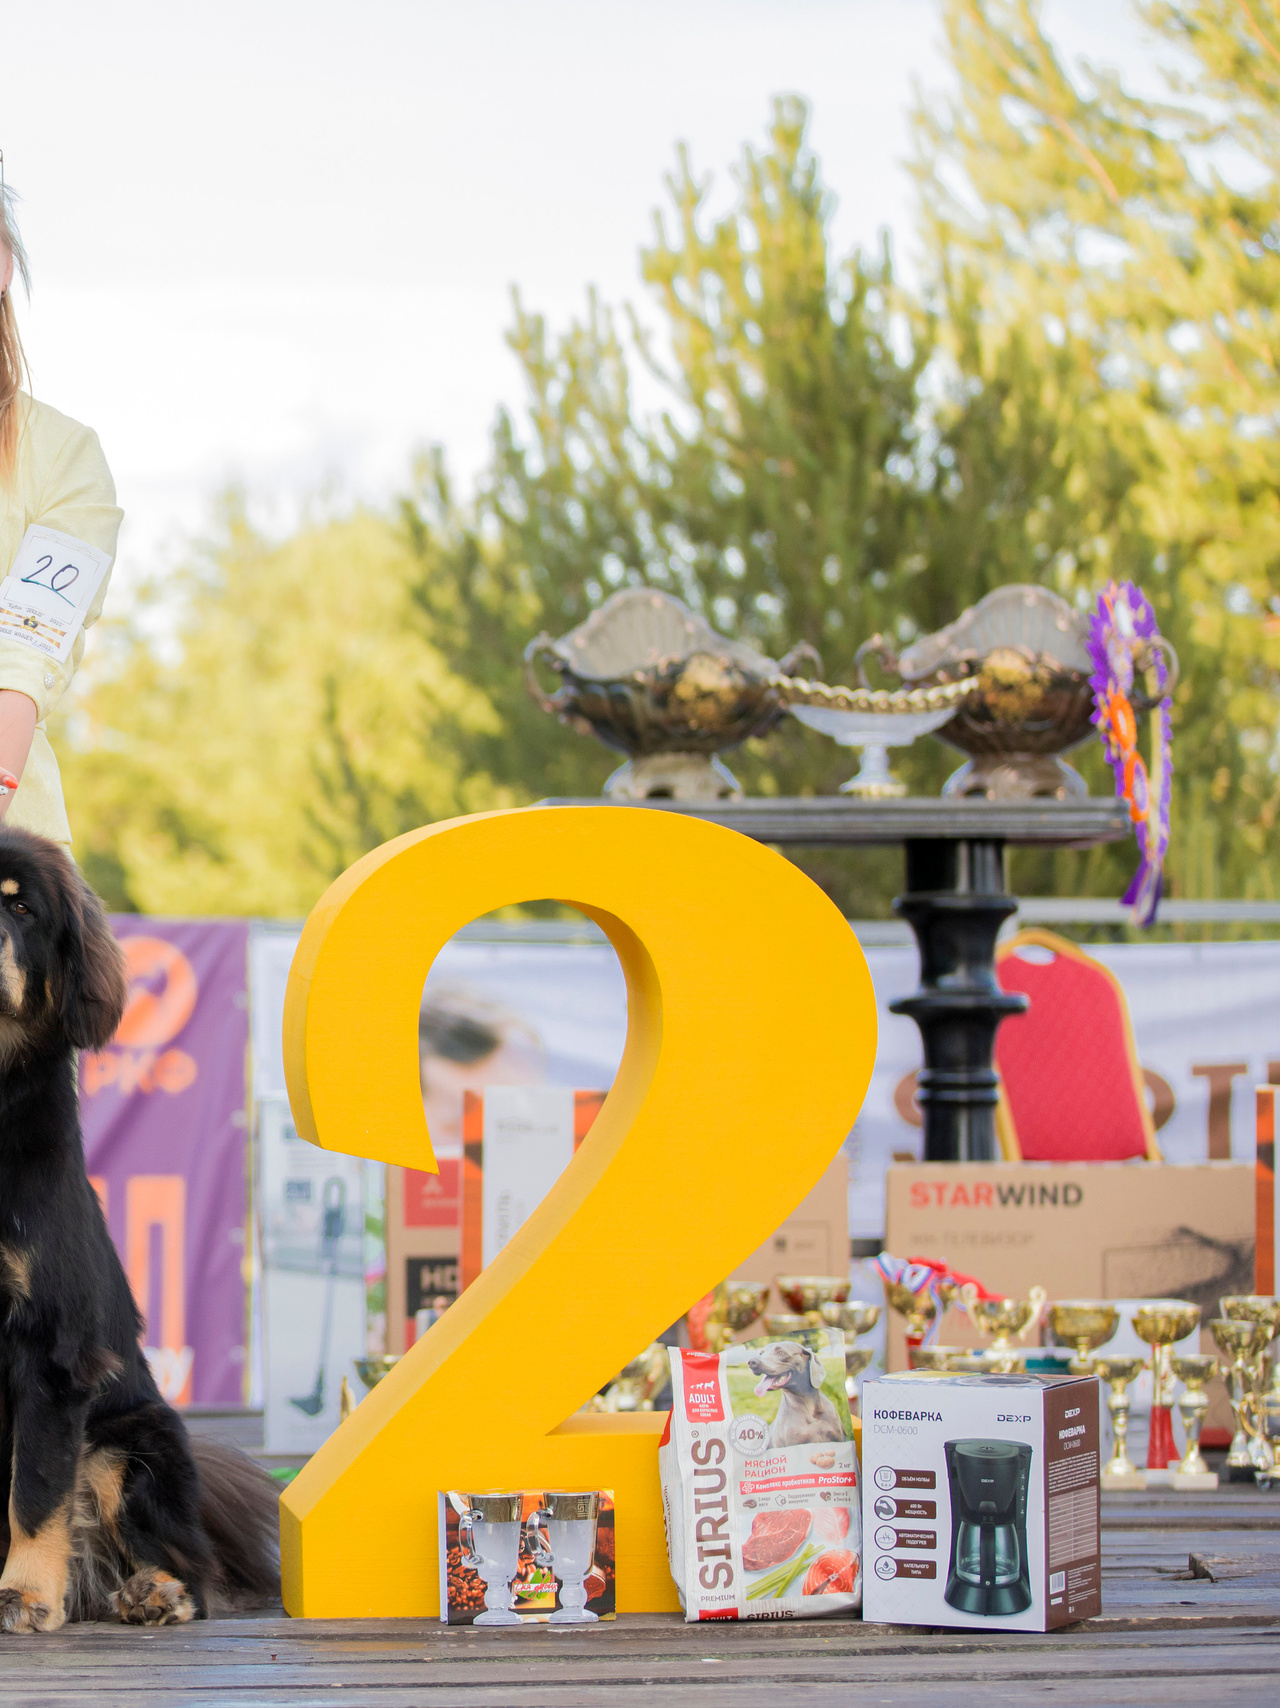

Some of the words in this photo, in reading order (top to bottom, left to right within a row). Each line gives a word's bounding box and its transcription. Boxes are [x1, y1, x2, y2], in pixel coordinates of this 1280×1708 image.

[20, 555, 80, 592] 20
[909, 1181, 1084, 1210] STARWIND
[280, 806, 878, 1619] 2
[689, 1393, 716, 1404] ADULT
[873, 1410, 943, 1422] КОФЕВАРКА
[997, 1414, 1032, 1423] DEXP
[1064, 1407, 1081, 1419] DEXP
[738, 1428, 764, 1441] 40%
[873, 1425, 918, 1435] DCM-0600
[1058, 1424, 1086, 1440] КОФЕВАРКА
[744, 1454, 787, 1468] МЯСНОЙ
[744, 1466, 786, 1478] РАЦИОН
[755, 1482, 782, 1490] Комплекс
[782, 1478, 816, 1487] пробиотиков
[818, 1475, 853, 1484] ProStor+
[691, 1437, 734, 1590] SIRIUS
[700, 1594, 736, 1602] PREMIUM
